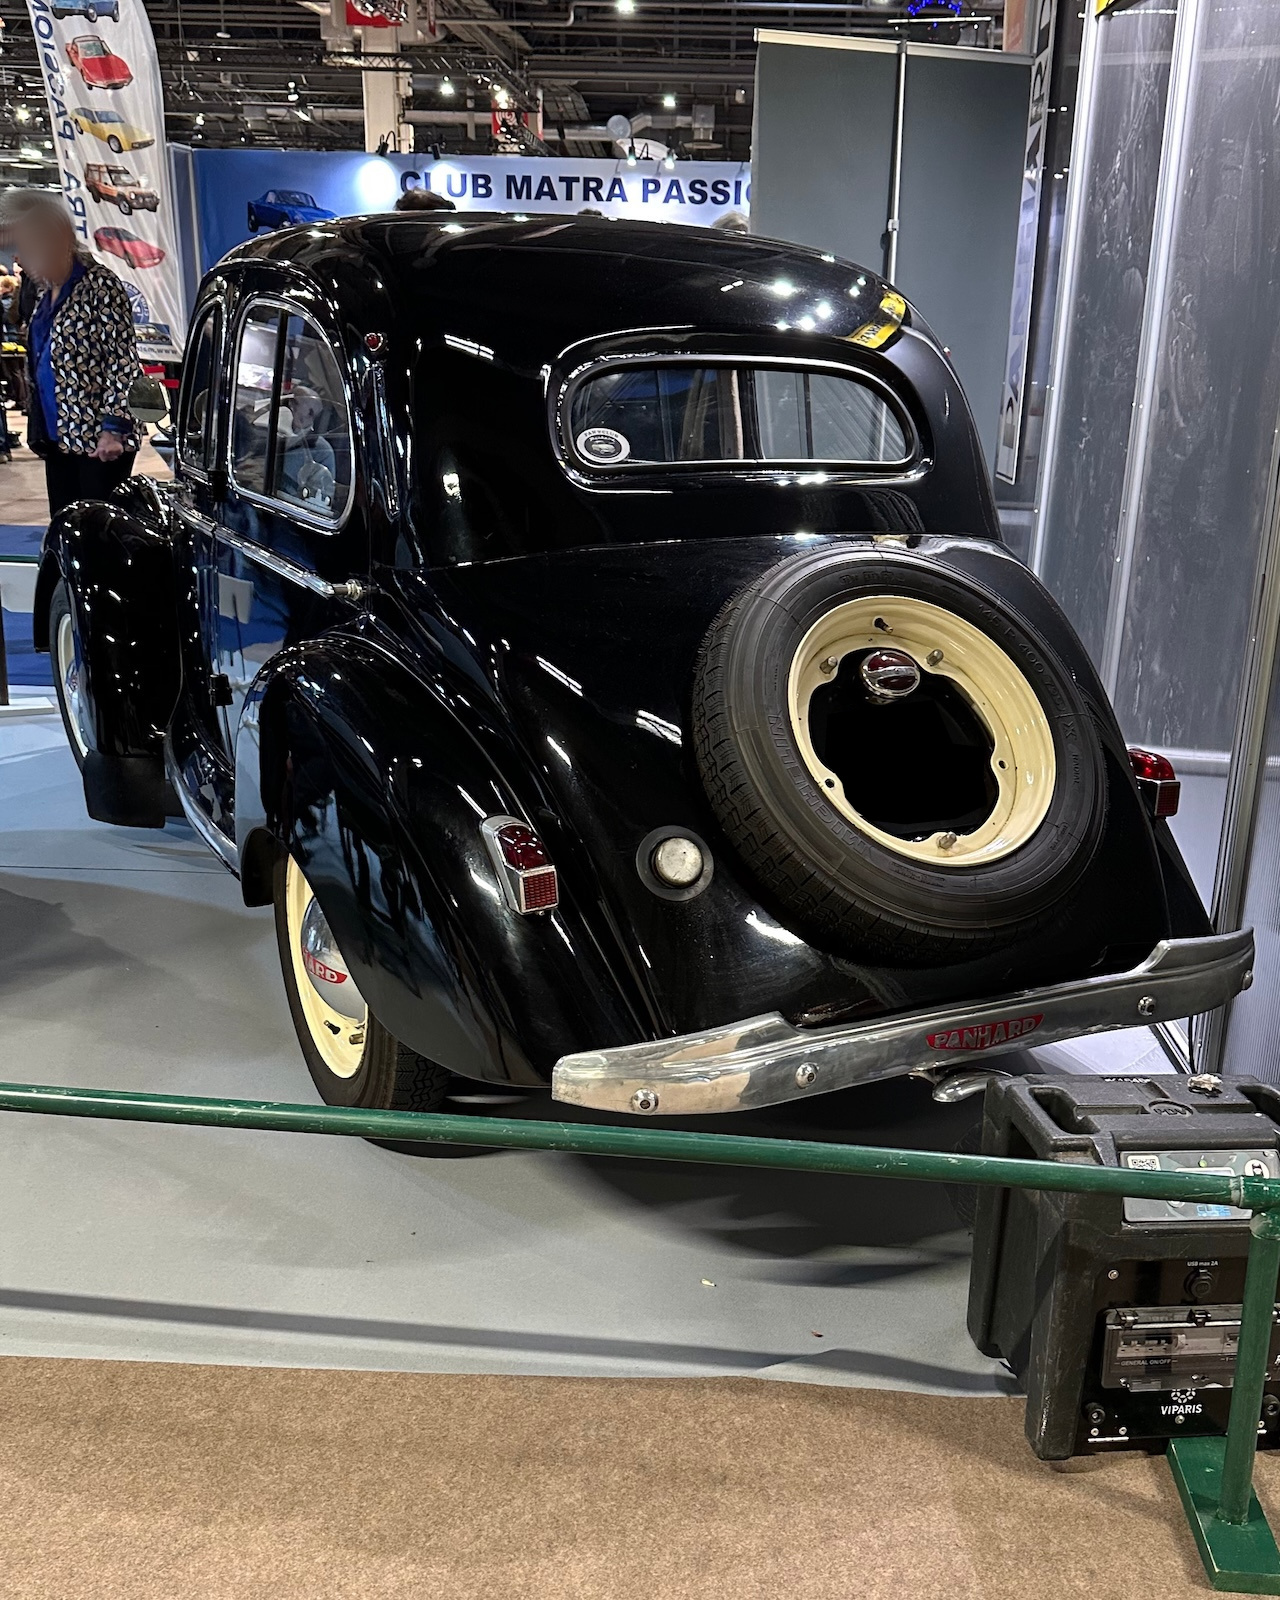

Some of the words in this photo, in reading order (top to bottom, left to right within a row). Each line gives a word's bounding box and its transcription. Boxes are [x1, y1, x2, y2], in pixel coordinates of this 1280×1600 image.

[505, 174, 629, 203] MATRA
[767, 714, 868, 855] MICHELIN
[933, 1018, 1037, 1048] PANHARD
[1121, 1359, 1148, 1367] GENERAL
[1160, 1403, 1203, 1416] VIPARIS
